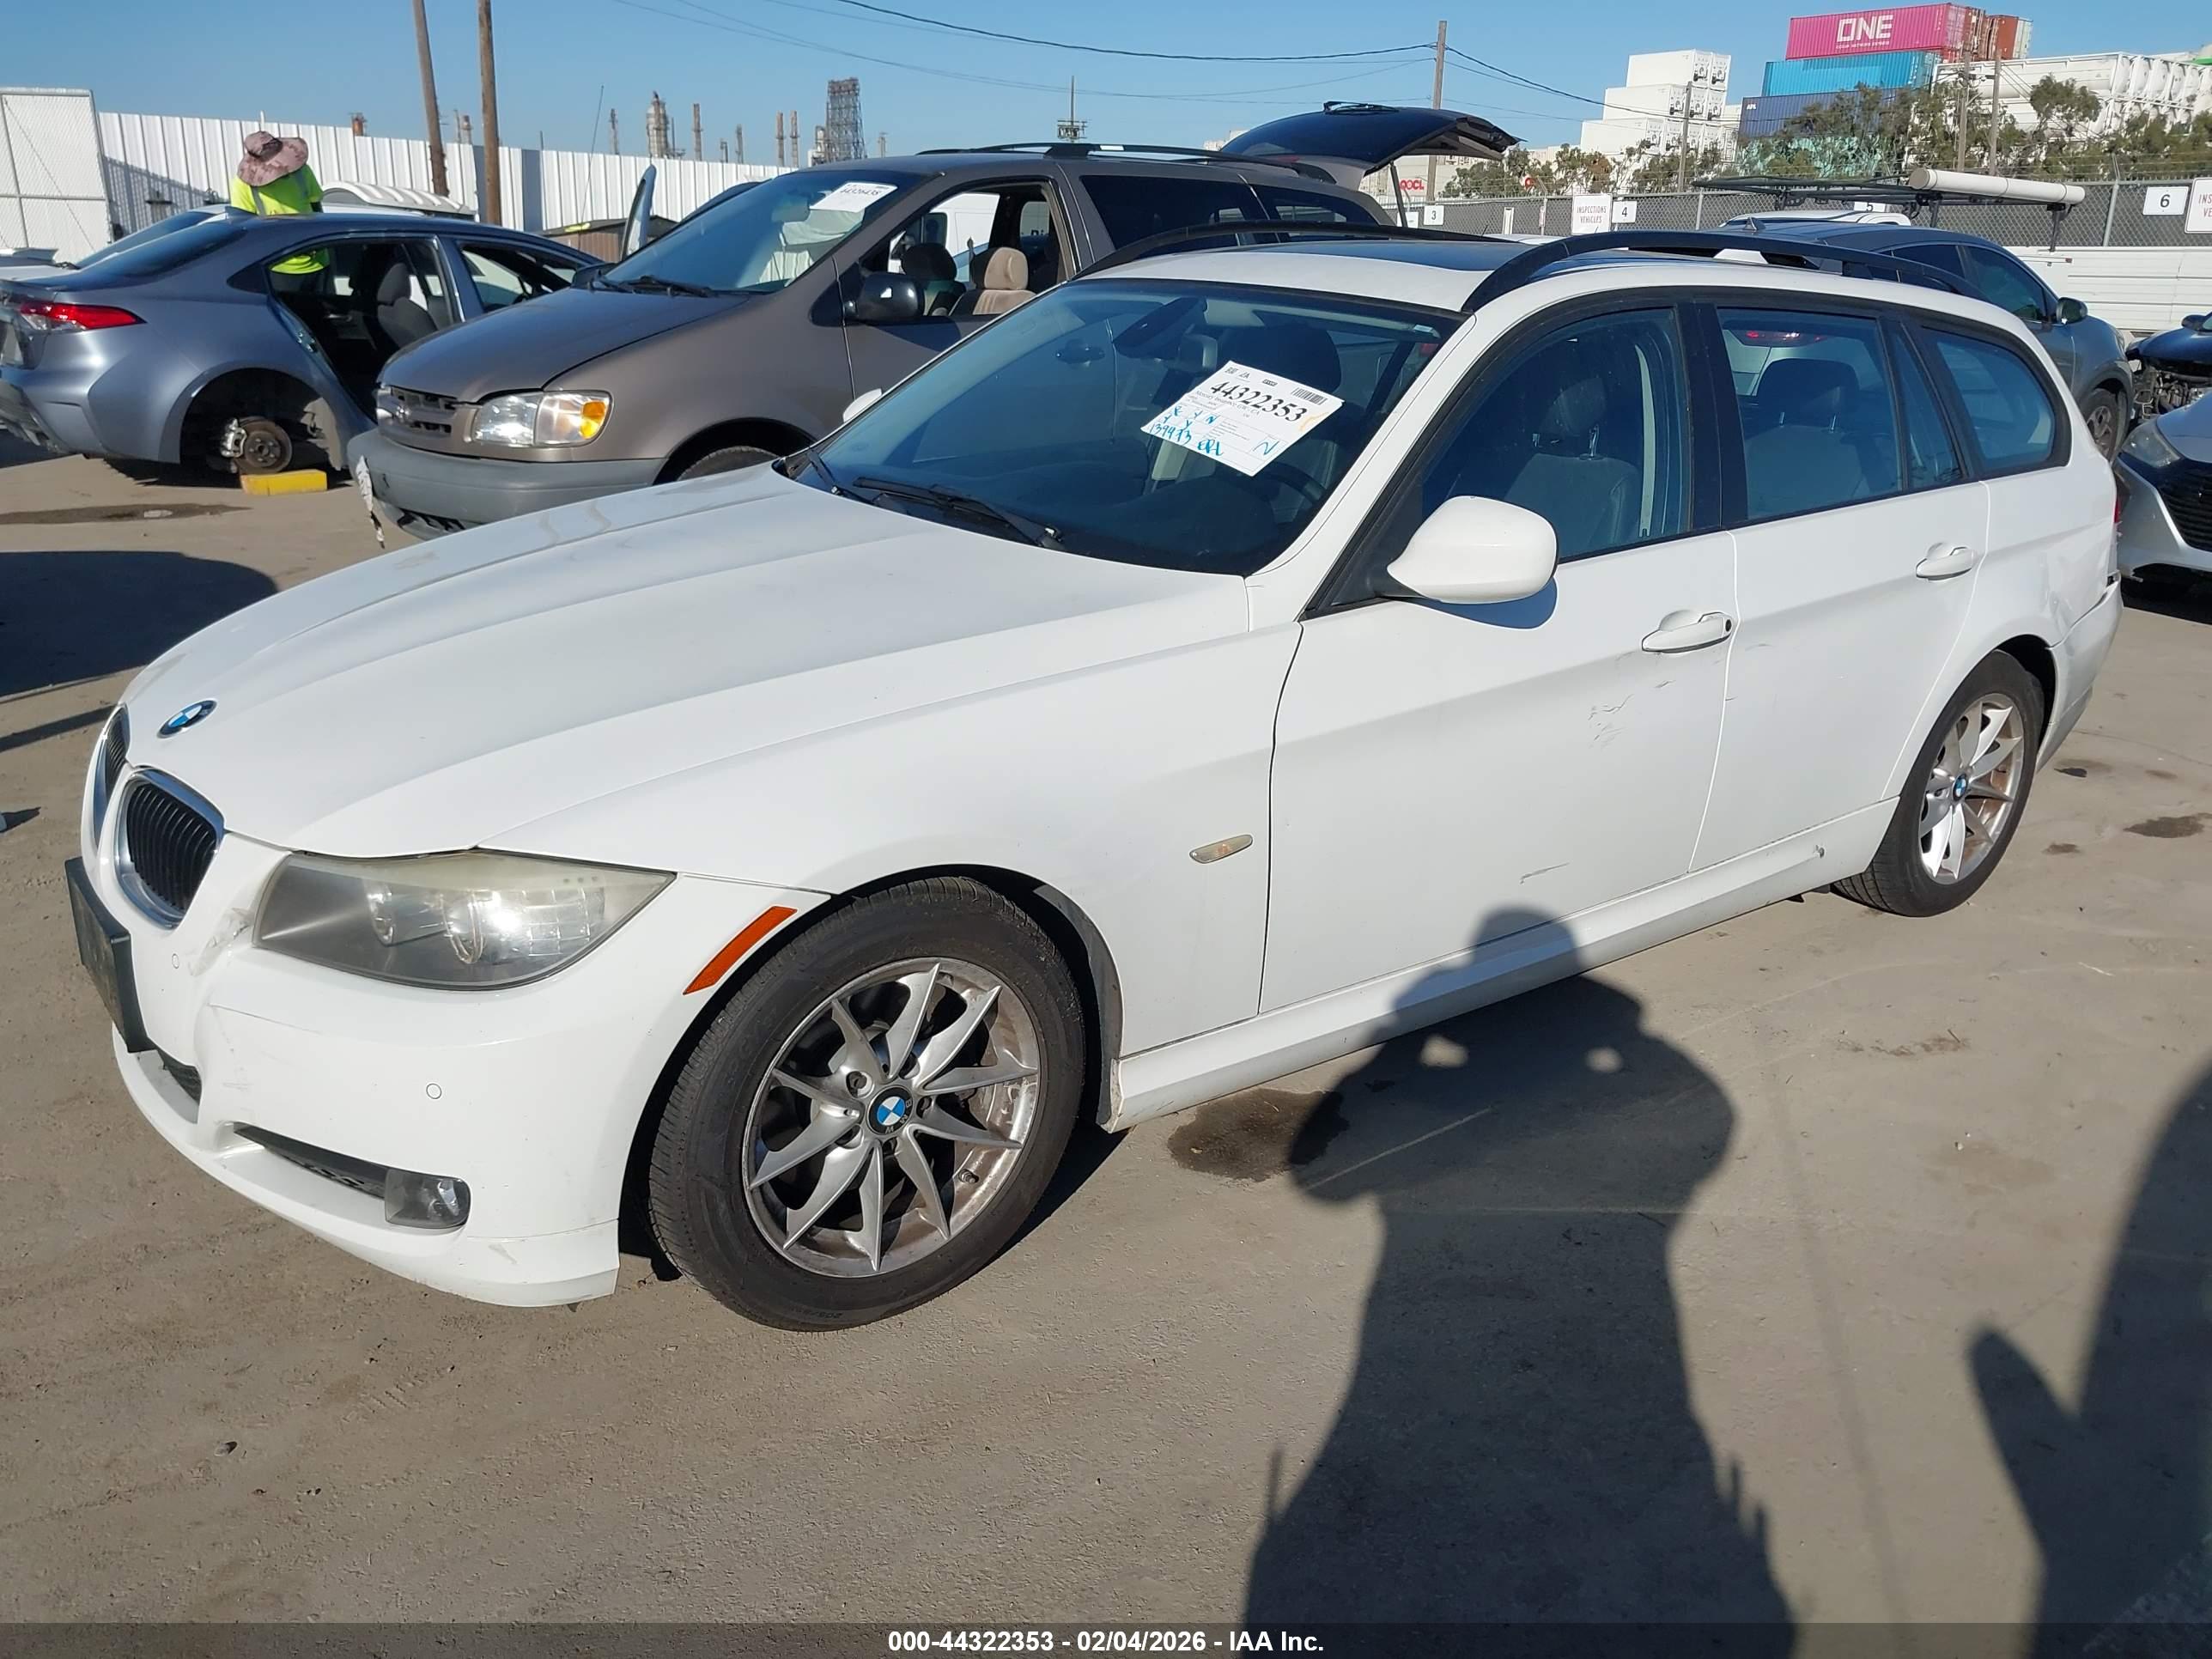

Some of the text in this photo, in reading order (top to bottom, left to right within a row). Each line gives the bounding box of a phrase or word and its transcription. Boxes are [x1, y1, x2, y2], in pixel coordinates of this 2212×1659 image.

[1837, 15, 1893, 42] ONE
[1866, 202, 1874, 212] 5
[2160, 194, 2171, 208] 6
[1431, 210, 1437, 220] 3
[1621, 207, 1628, 217] 4
[1210, 380, 1308, 422] 44322353
